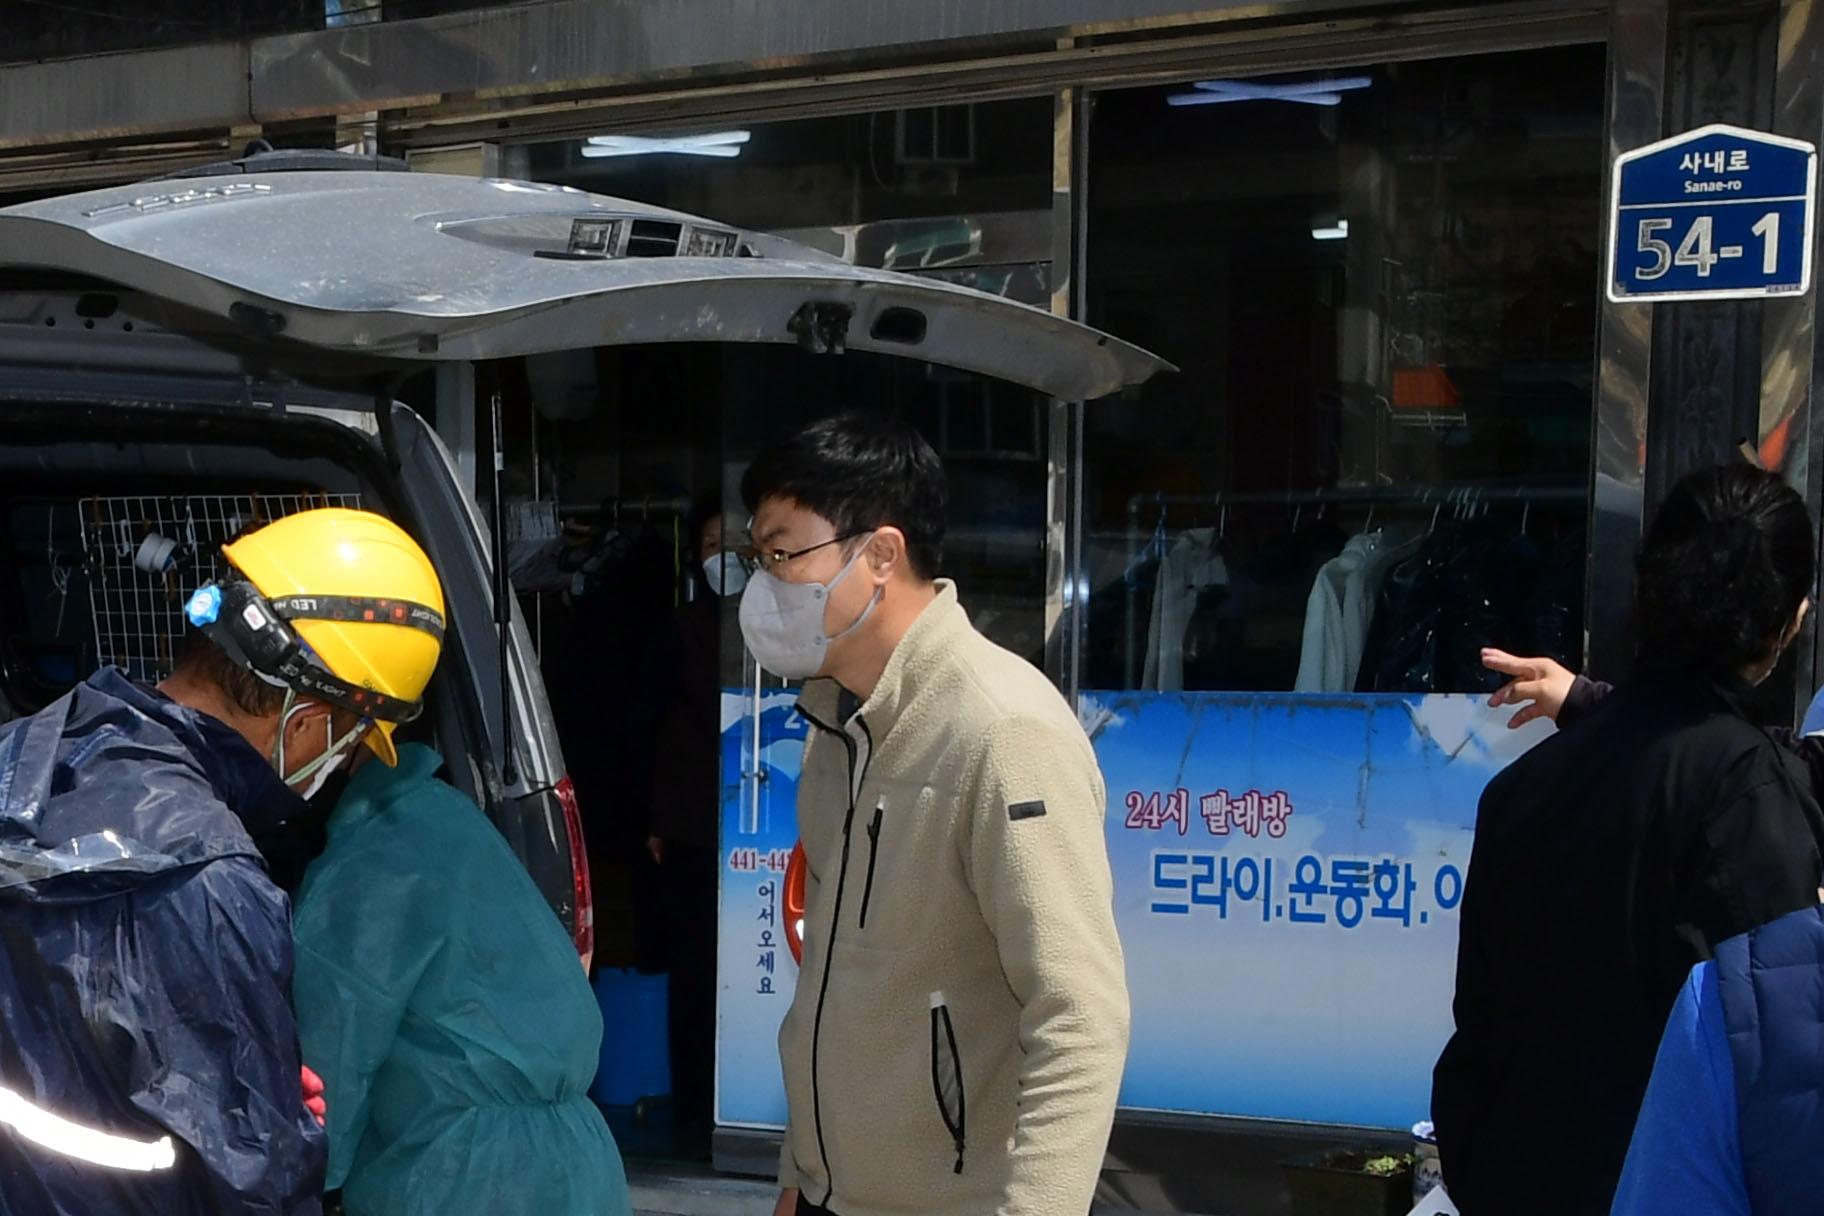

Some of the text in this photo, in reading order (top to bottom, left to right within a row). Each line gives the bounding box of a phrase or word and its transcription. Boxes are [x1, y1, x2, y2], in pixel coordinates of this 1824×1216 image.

[1679, 150, 1750, 175] 사내로
[1684, 179, 1742, 194] Sanae-ro
[1634, 212, 1780, 281] 54-1
[1125, 789, 1293, 838] 24시 빨래방
[728, 849, 792, 871] 441-44
[755, 880, 778, 995] 어서오세요
